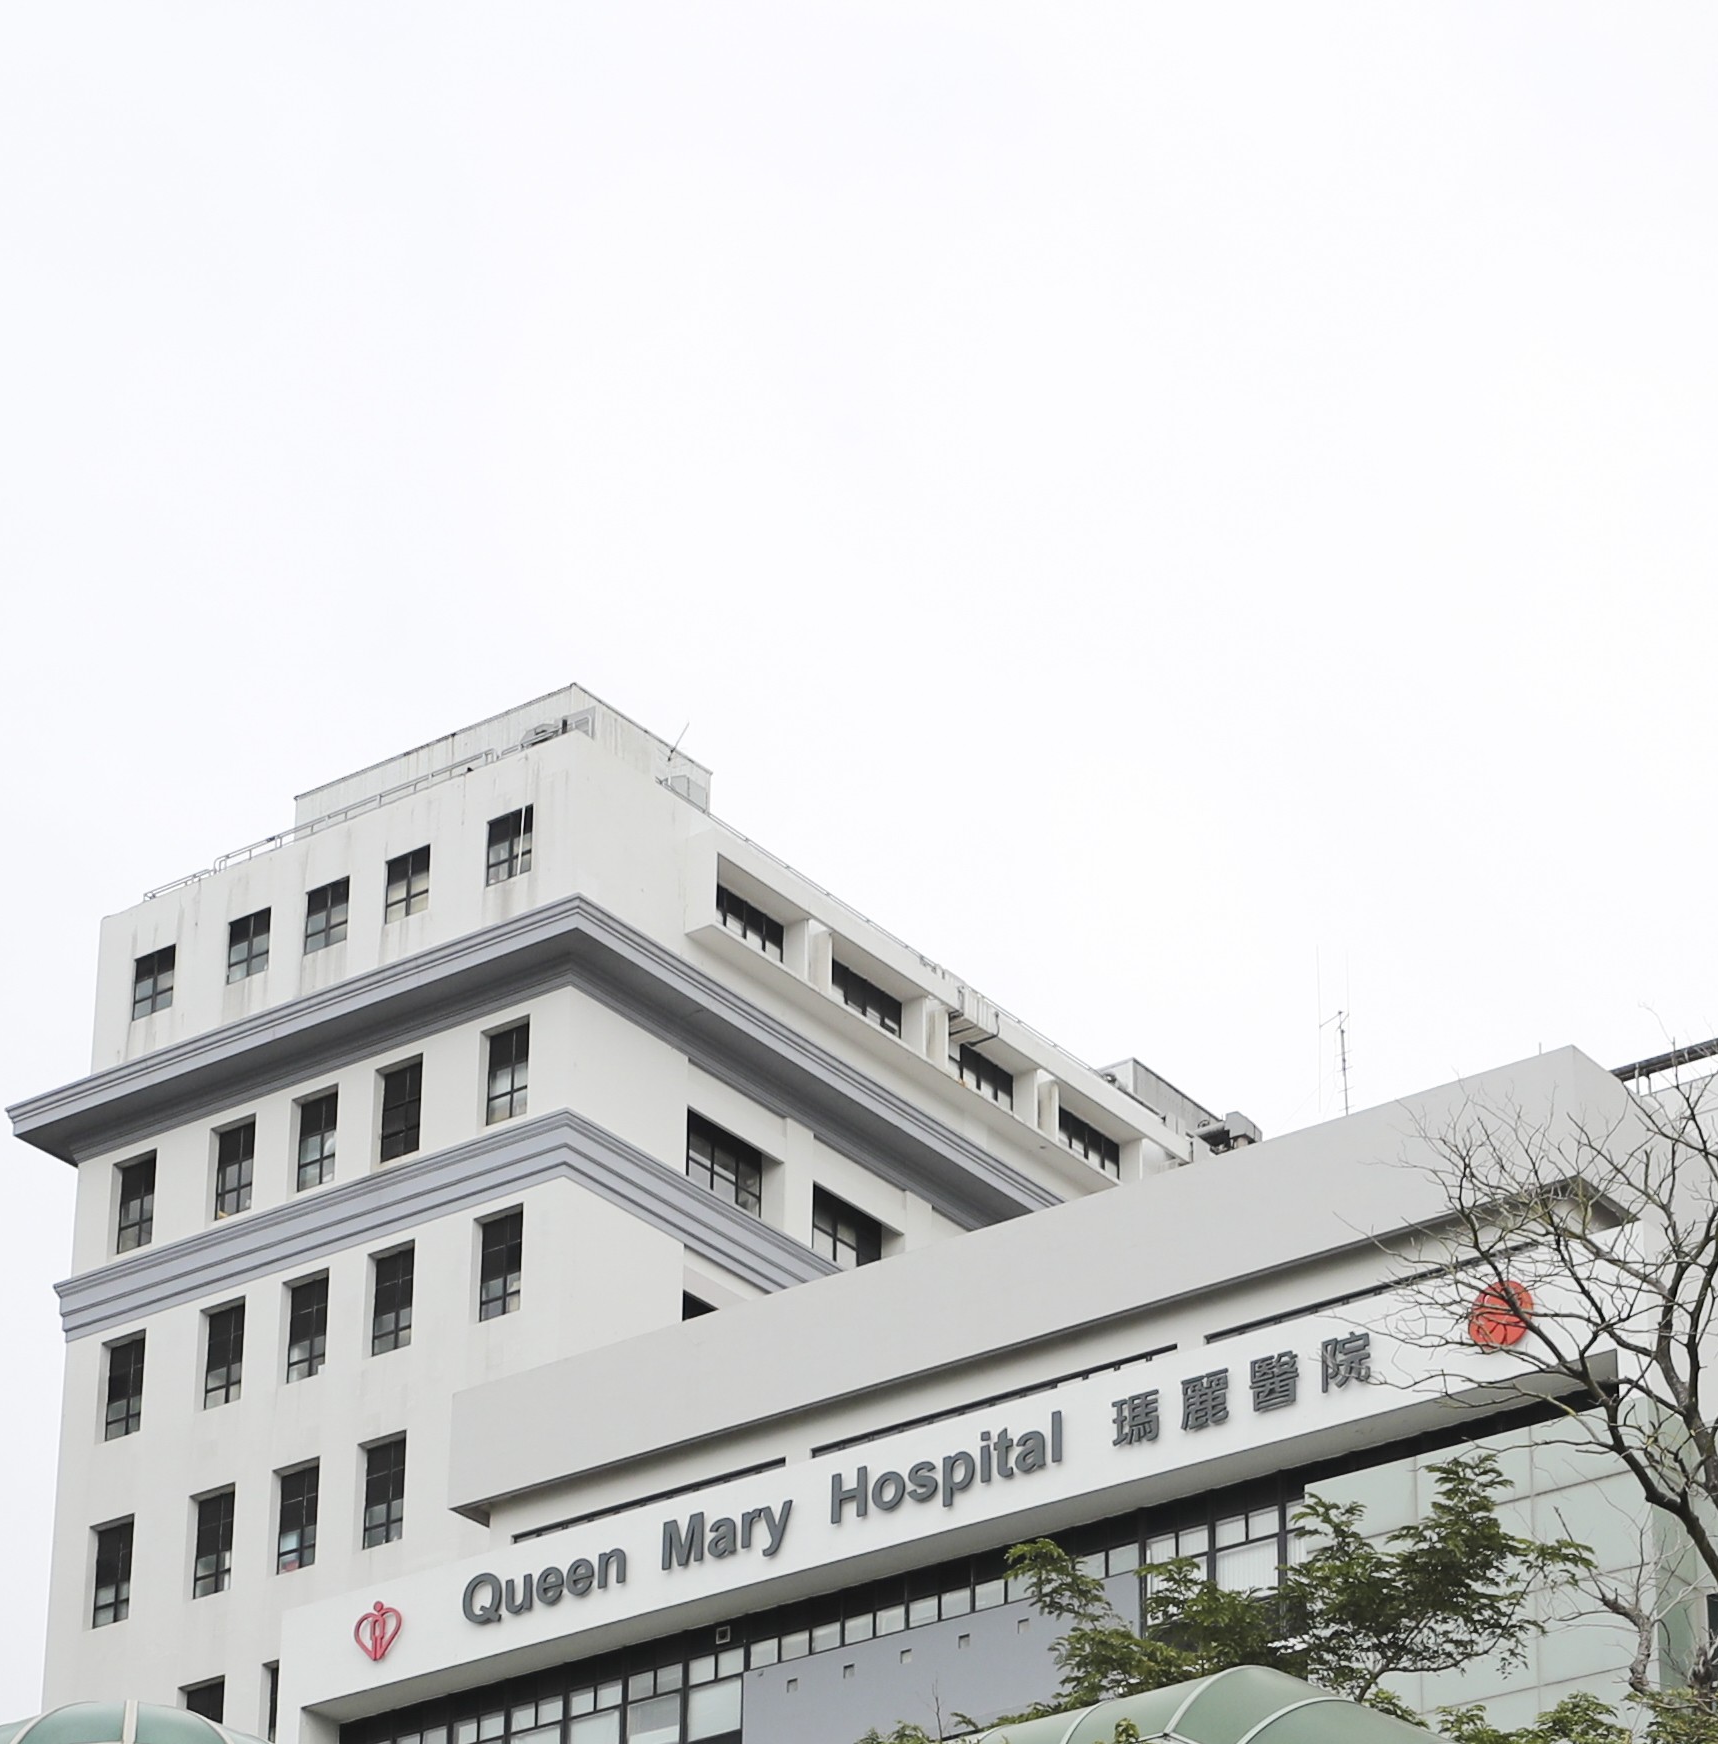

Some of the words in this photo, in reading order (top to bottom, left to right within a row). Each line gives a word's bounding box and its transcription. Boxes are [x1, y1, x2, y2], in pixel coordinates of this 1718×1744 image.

[1112, 1331, 1372, 1447] 瑪麗醫院
[462, 1547, 627, 1626] Queen
[661, 1499, 793, 1571] Mary
[830, 1410, 1063, 1525] Hospital
